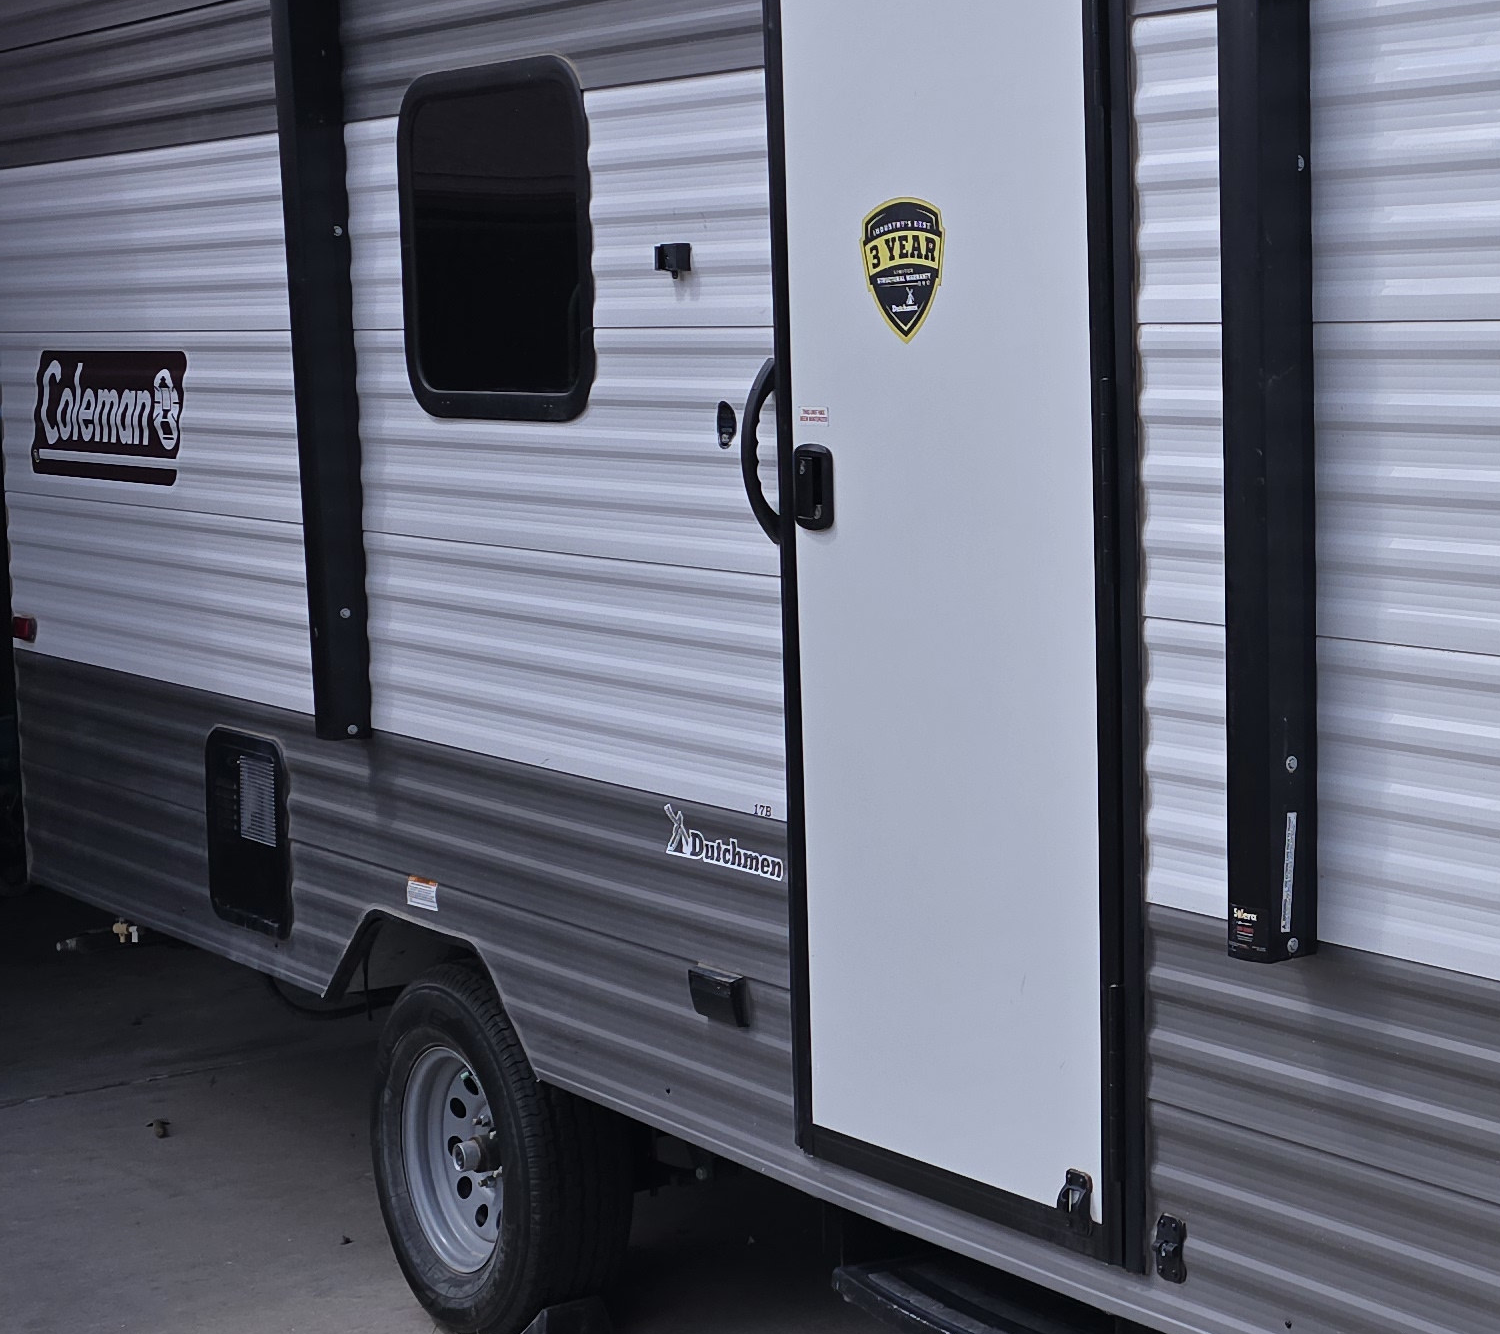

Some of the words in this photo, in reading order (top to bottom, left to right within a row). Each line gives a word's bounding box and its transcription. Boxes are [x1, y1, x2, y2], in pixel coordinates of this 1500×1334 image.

[869, 244, 881, 269] 3
[884, 234, 937, 263] YEAR
[40, 359, 152, 446] Coleman
[753, 803, 772, 817] 17B
[689, 830, 783, 881] Dutchmen
